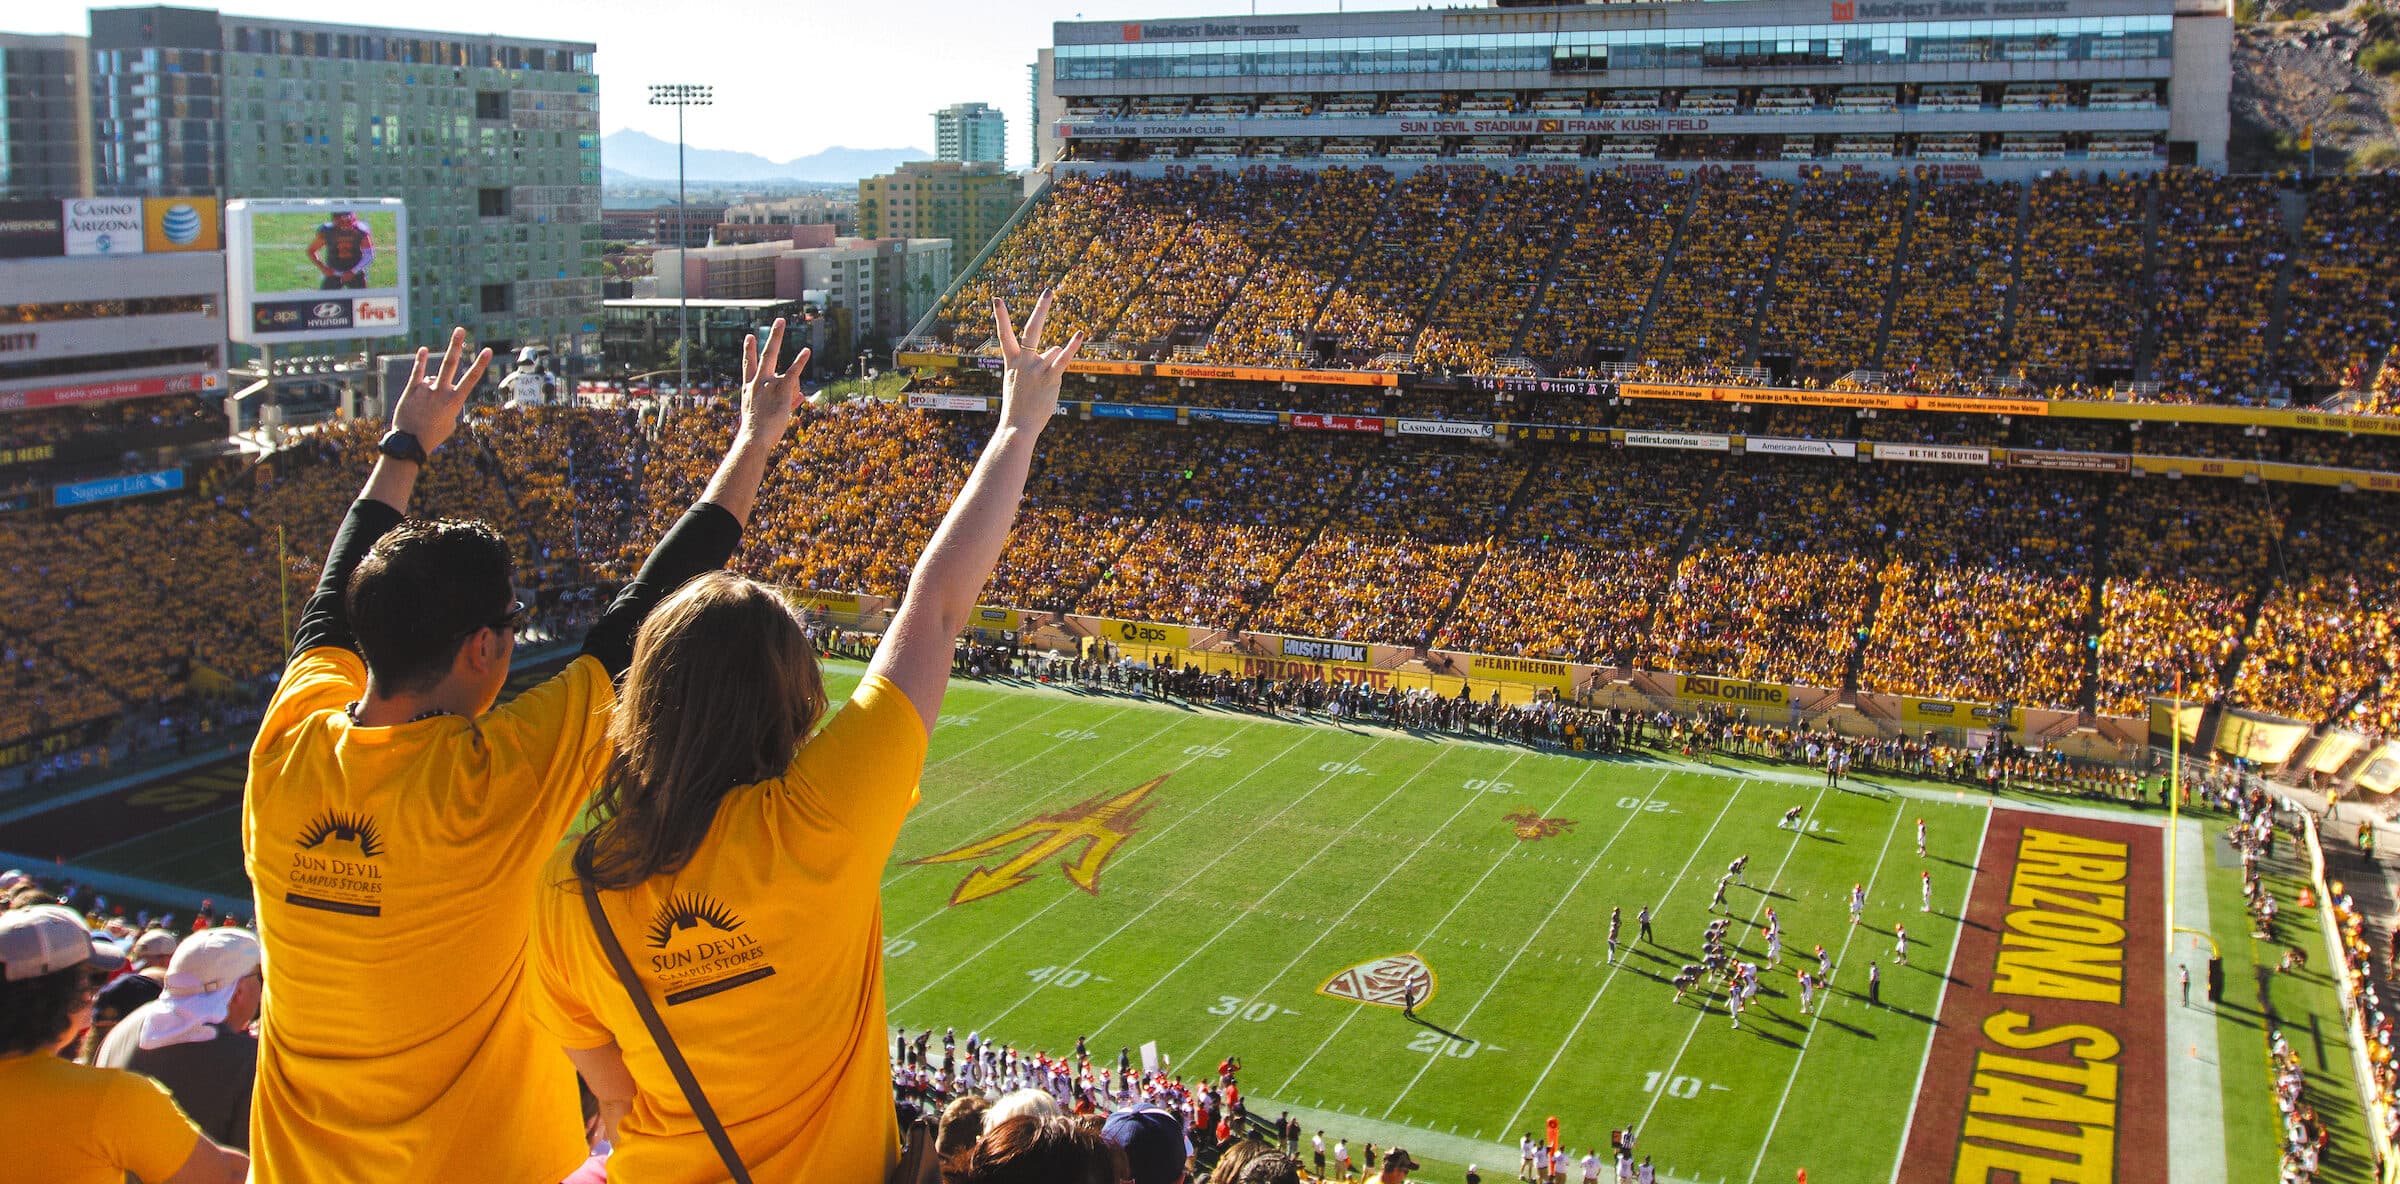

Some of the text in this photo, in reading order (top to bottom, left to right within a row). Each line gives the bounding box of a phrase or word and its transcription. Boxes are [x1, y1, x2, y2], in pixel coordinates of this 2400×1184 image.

[1143, 126, 1192, 135] STADIUM
[1194, 126, 1225, 135] CLUB
[1400, 122, 1429, 133] SUN
[1432, 122, 1469, 132] DEVIL
[1474, 121, 1532, 132] STADIUM
[1568, 120, 1617, 132] FRANK
[1621, 119, 1661, 131] KUSH
[1667, 119, 1708, 130] FIELD
[73, 202, 133, 216] CASINO
[67, 218, 139, 232] ARIZONA
[273, 310, 298, 324] aps
[308, 317, 348, 328] HYUNDAI
[1171, 367, 1184, 376] the
[1185, 368, 1216, 377] diehard
[1217, 369, 1237, 378] card.
[1481, 380, 1494, 390] 14
[1550, 383, 1576, 393] 11:10
[1601, 384, 1609, 394] 7
[1401, 422, 1479, 435] CASINO ARIZONA
[1627, 434, 1699, 446] midfirst.com/asu
[1761, 442, 1825, 453] American Airlines
[1922, 450, 1938, 458] THE
[1941, 451, 1984, 461] SOLUTION
[2201, 463, 2224, 474] ASU
[1139, 626, 1166, 643] aps
[1334, 645, 1367, 662] MILK
[1243, 657, 1391, 692] ARIZONA STATE
[1474, 657, 1567, 677] #FEARTHEFORK
[1684, 677, 1783, 704] ASU online
[1616, 796, 1671, 814] 20
[292, 852, 382, 879] SUN DEVIL
[290, 870, 338, 888] CAMPUS
[338, 878, 382, 894] STORES
[1992, 826, 2130, 1008] ARIZONA
[651, 933, 757, 973] SUN DEVIL
[658, 962, 713, 981] CAMPUS
[713, 945, 764, 971] STORES
[1025, 965, 1091, 989] 40
[1207, 995, 1278, 1023] 30
[1406, 1030, 1482, 1060] 20
[1642, 1071, 1703, 1100] 10
